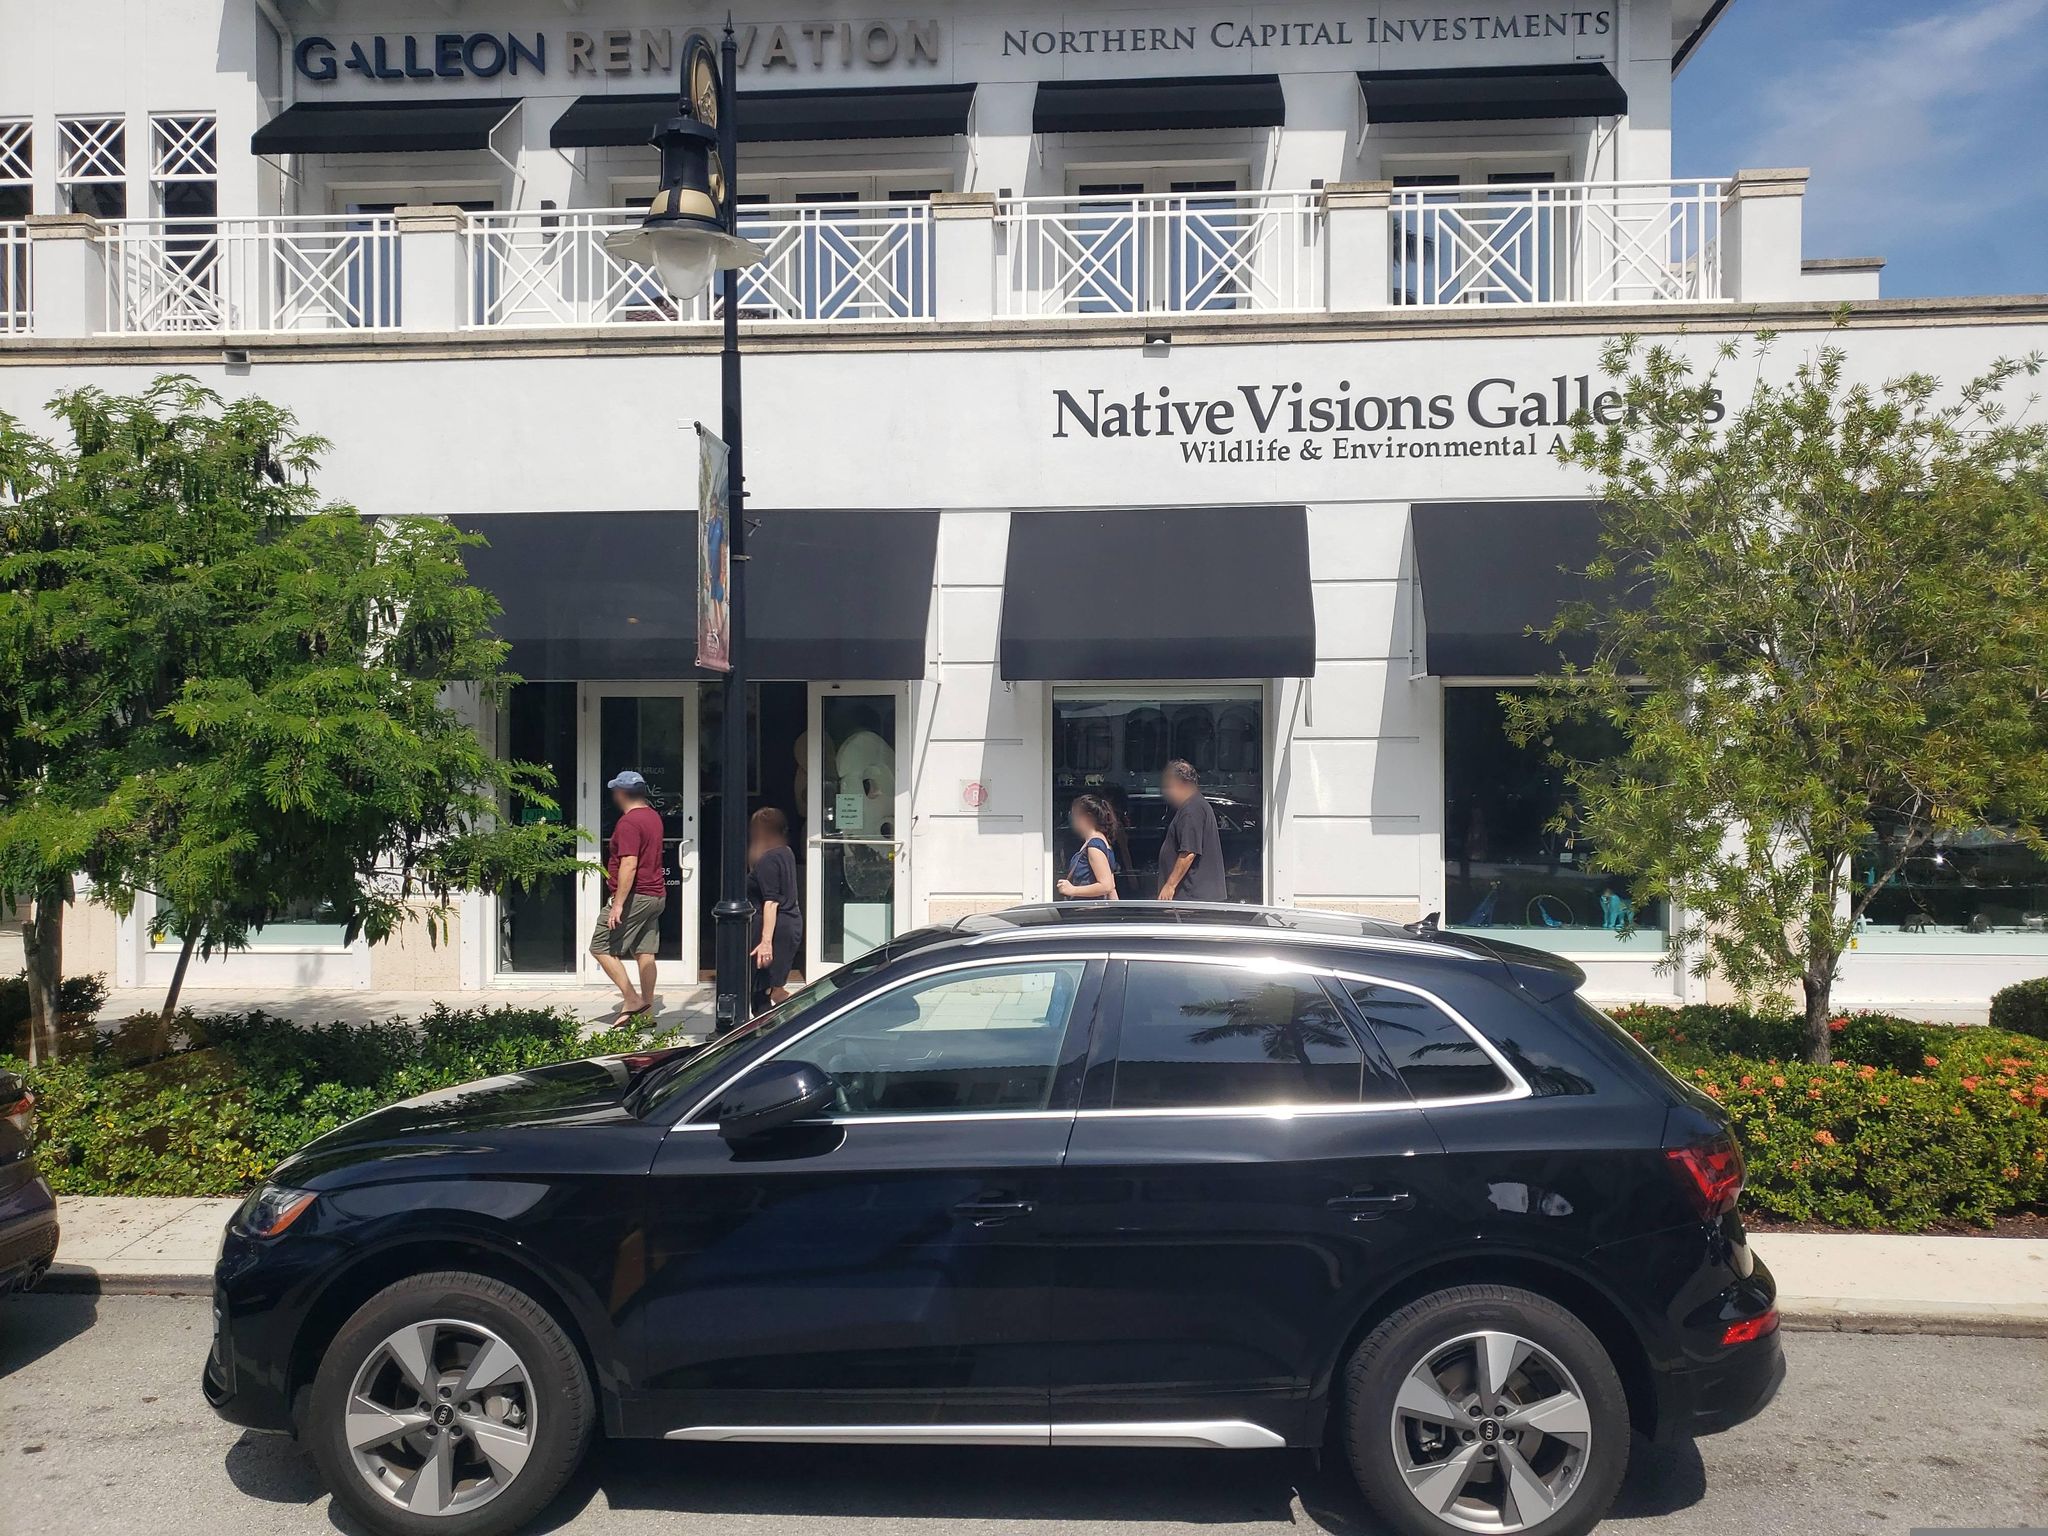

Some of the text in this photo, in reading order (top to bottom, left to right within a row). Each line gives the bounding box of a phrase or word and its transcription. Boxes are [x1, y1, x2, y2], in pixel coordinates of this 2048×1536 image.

[295, 32, 545, 80] GALLEON
[1002, 11, 1611, 56] NORTHERN CAPITAL INVESTMENTS
[1467, 374, 1725, 428] Galles
[1180, 438, 1291, 463] Wildlife
[1300, 438, 1323, 460] &
[1333, 433, 1538, 460] Environmental
